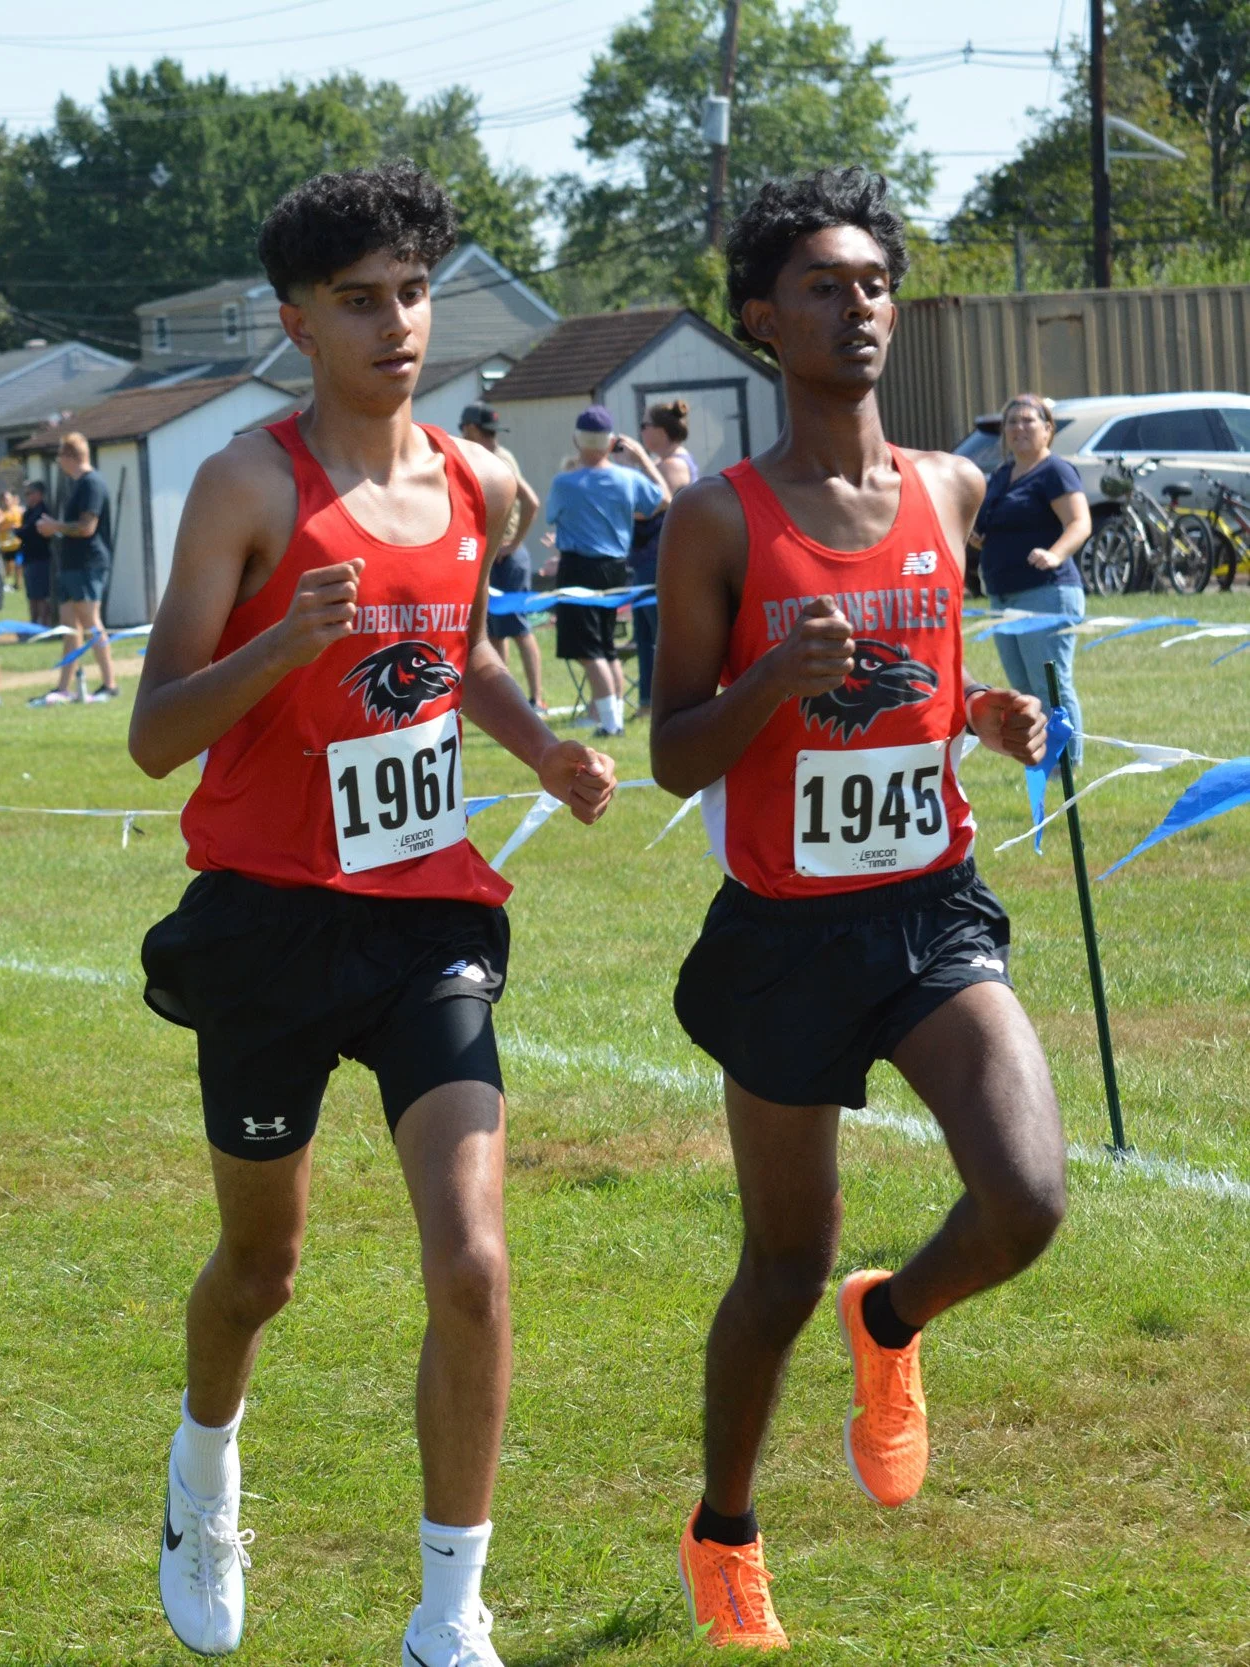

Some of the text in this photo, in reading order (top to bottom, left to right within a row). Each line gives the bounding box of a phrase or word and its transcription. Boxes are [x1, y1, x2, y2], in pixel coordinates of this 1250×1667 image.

[349, 603, 472, 635] OBBINSVILL
[762, 588, 949, 641] ROINSVILLE
[337, 735, 458, 840] 1967
[801, 765, 943, 844] 1945
